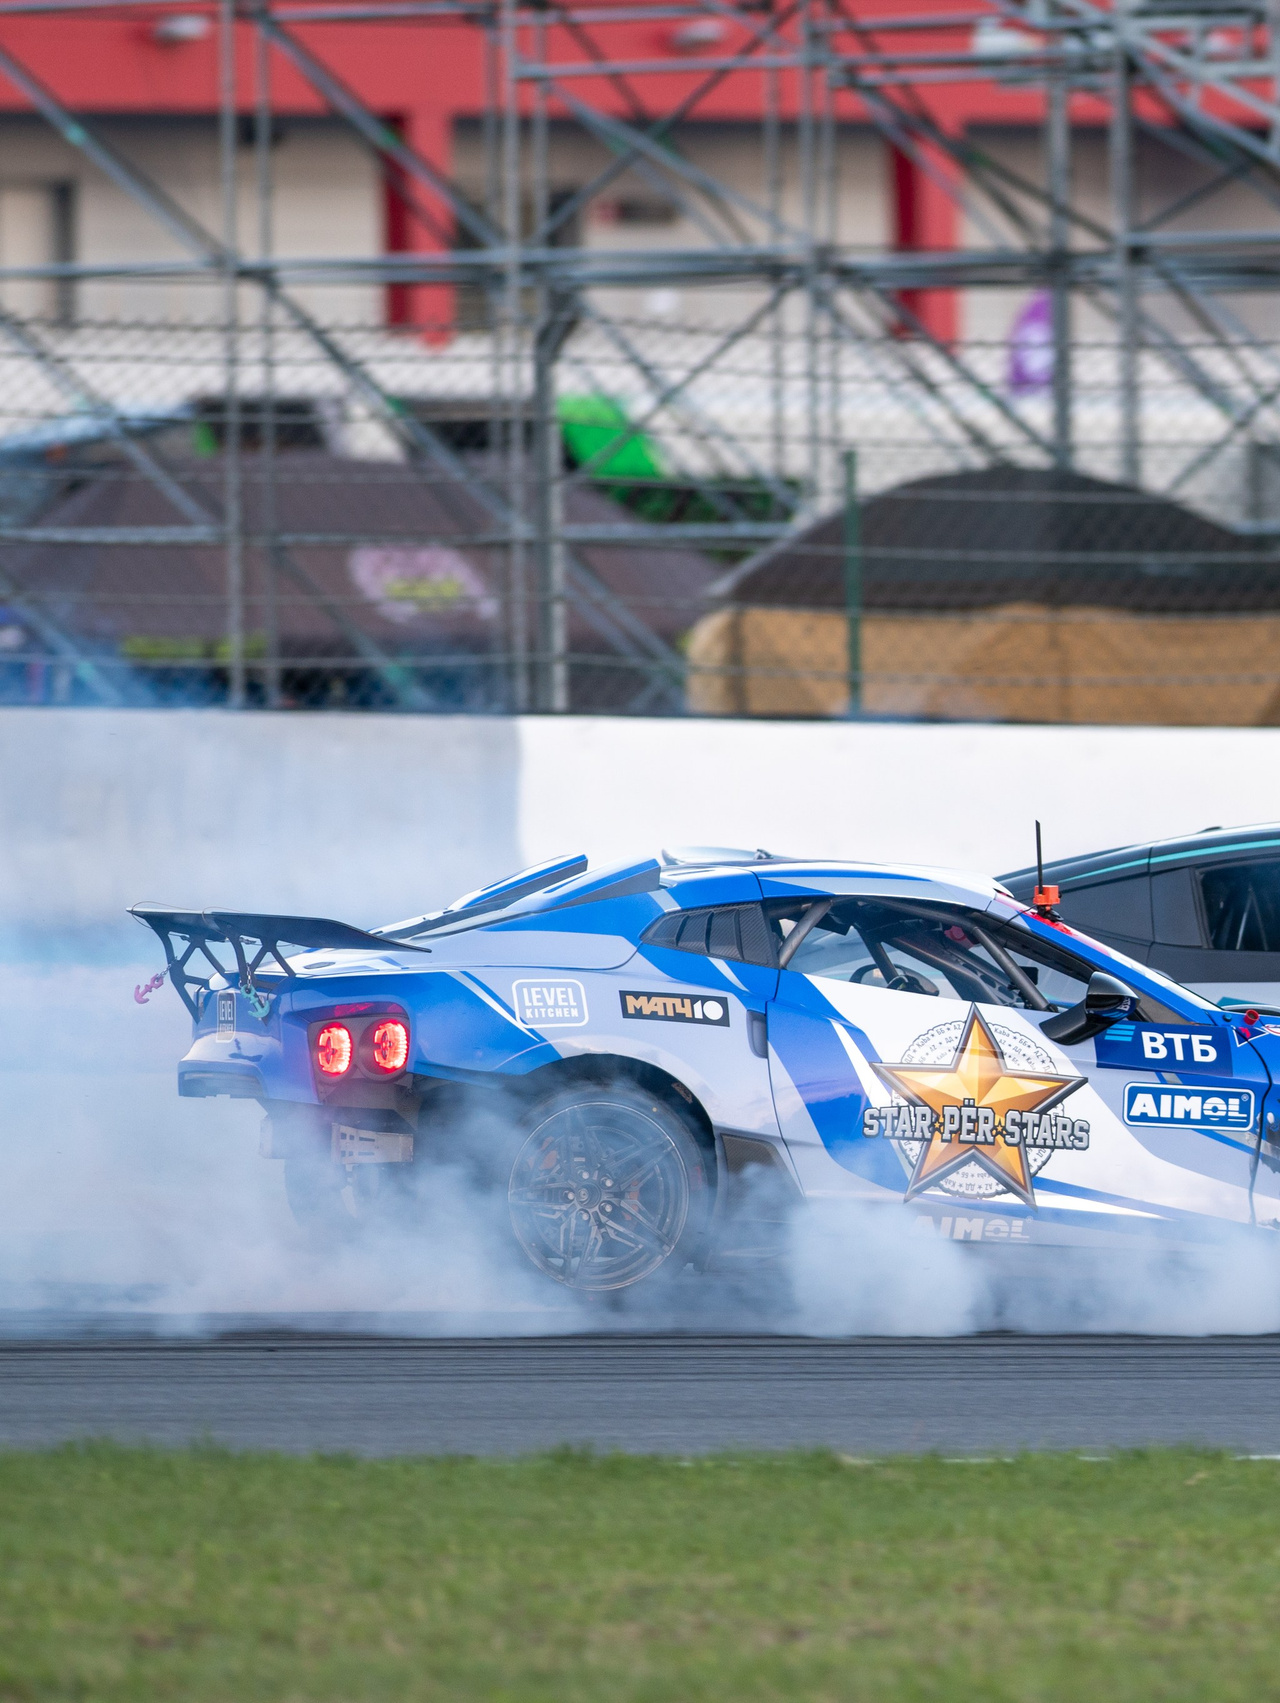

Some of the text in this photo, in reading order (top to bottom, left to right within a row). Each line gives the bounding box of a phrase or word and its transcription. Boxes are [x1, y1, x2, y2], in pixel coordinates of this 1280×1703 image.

[523, 987, 577, 1007] LEVEL
[526, 1007, 579, 1019] KITCHEN
[1141, 1031, 1217, 1062] ВТБ
[862, 1098, 1090, 1150] STAR PËR STARS
